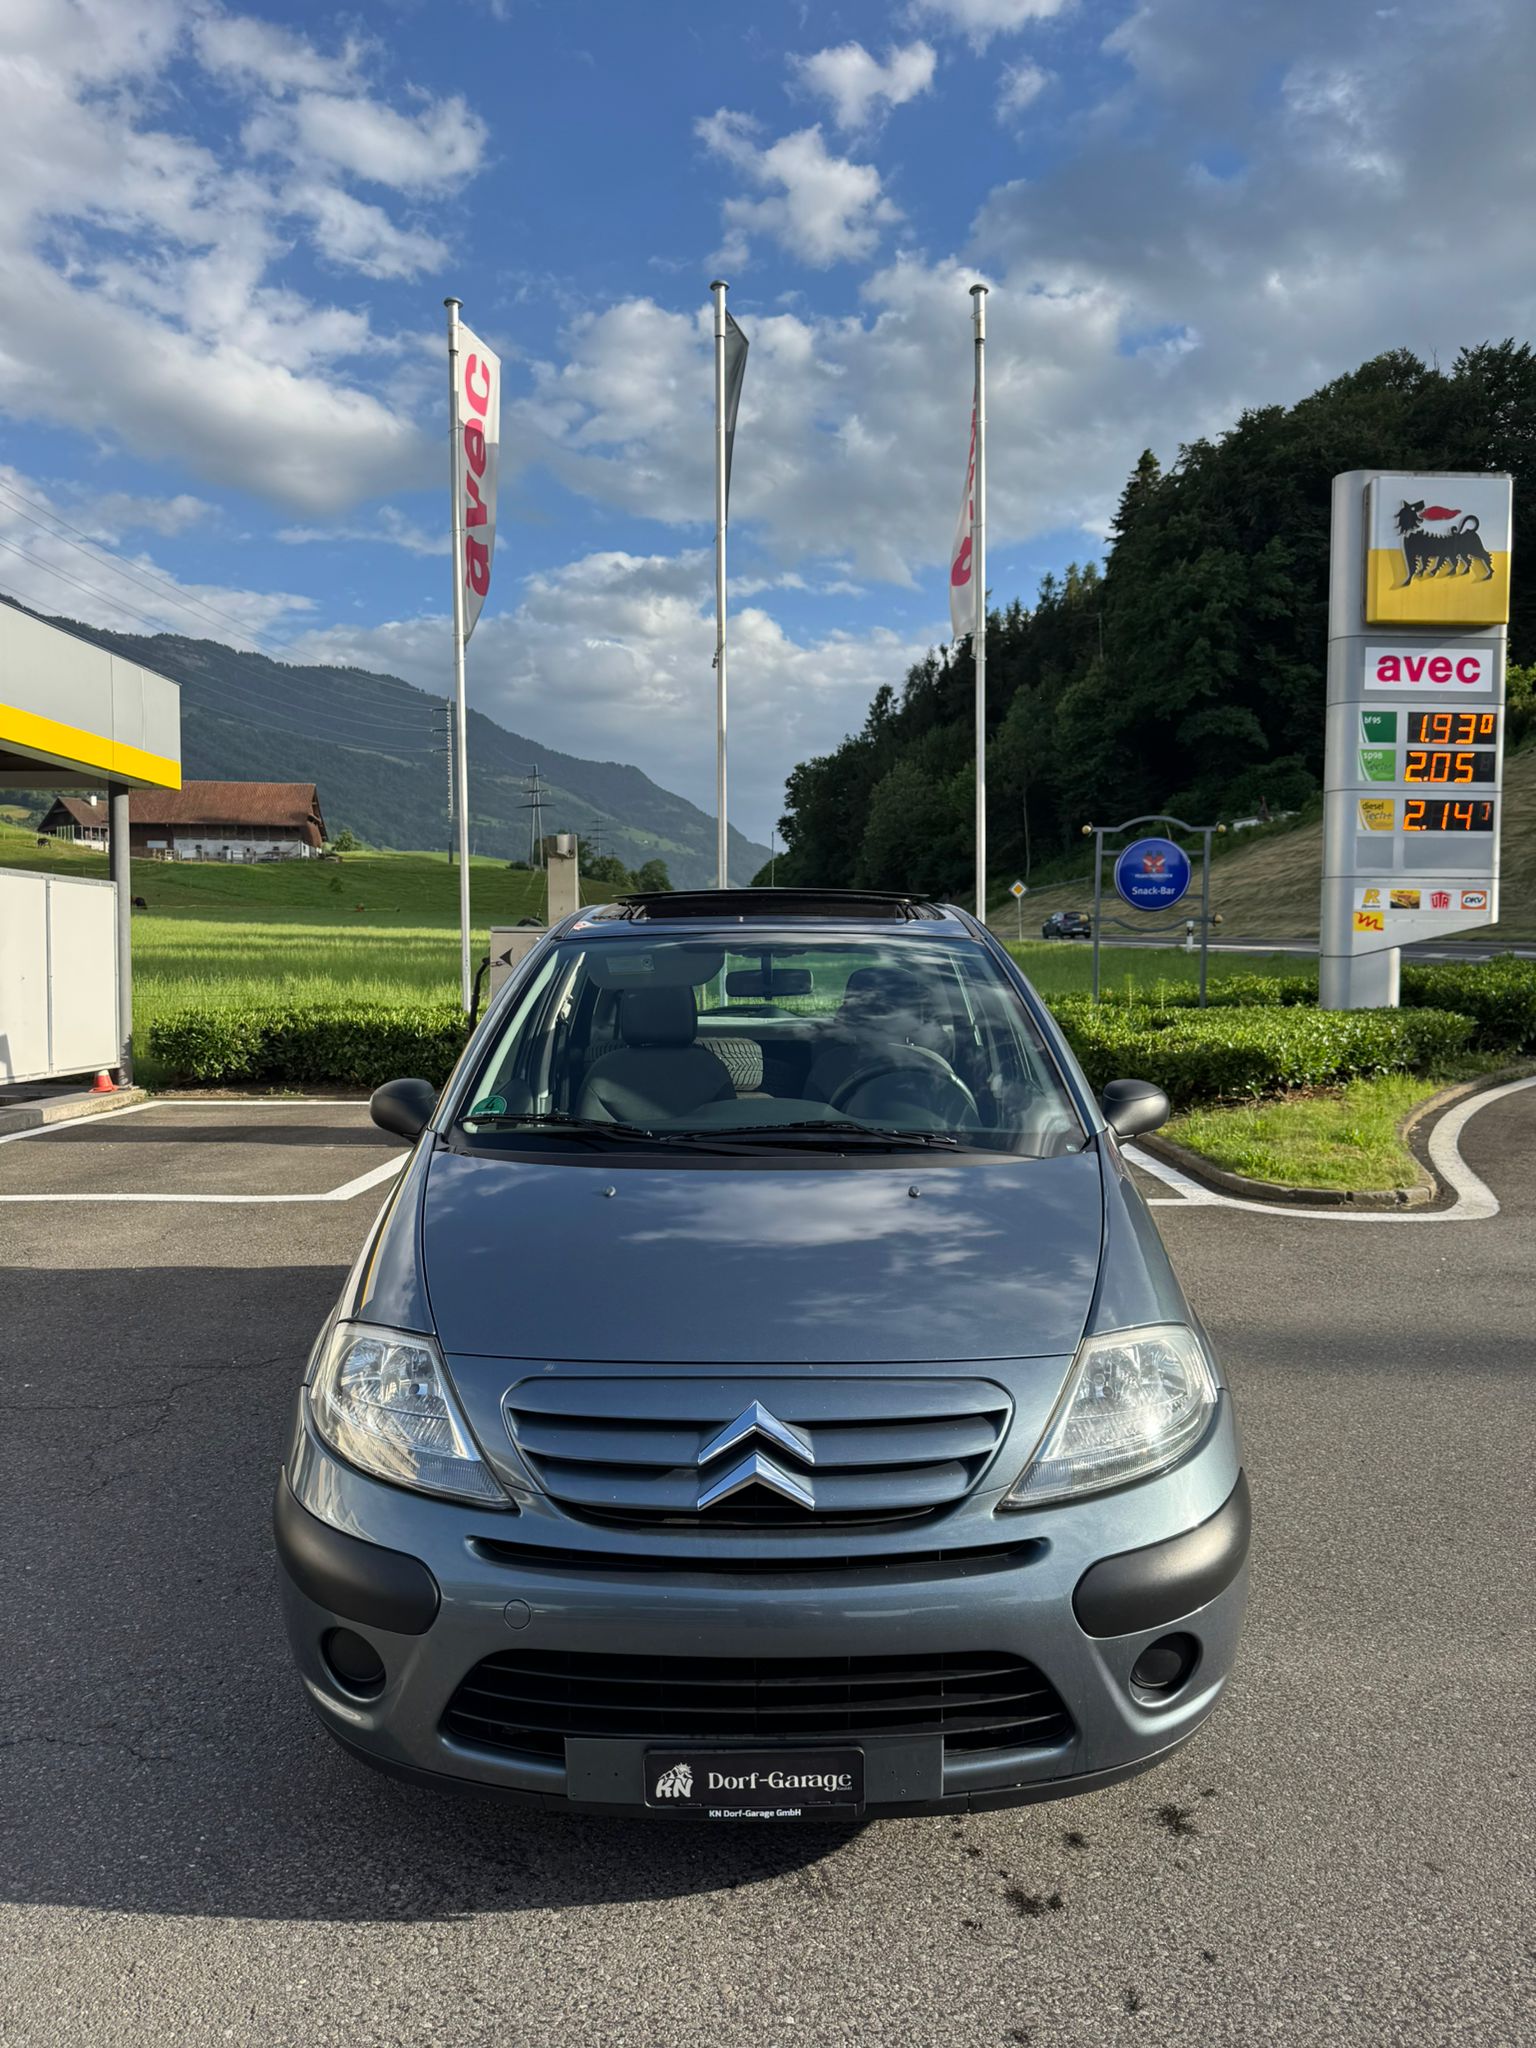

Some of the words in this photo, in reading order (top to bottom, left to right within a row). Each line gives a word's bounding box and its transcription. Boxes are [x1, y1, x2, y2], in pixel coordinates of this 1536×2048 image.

[464, 352, 491, 597] avec
[1376, 654, 1481, 684] avec
[1404, 751, 1475, 783] 2.05
[1362, 801, 1384, 811] diesel
[1131, 886, 1176, 896] Snack-Bar
[1464, 896, 1484, 904] DKV
[484, 1097, 496, 1111] 4
[655, 1776, 694, 1799] KN
[707, 1771, 853, 1792] Dorf-Garage
[708, 1808, 722, 1817] KN
[723, 1808, 775, 1819] Dorf-Garage
[776, 1808, 802, 1817] GmbH
